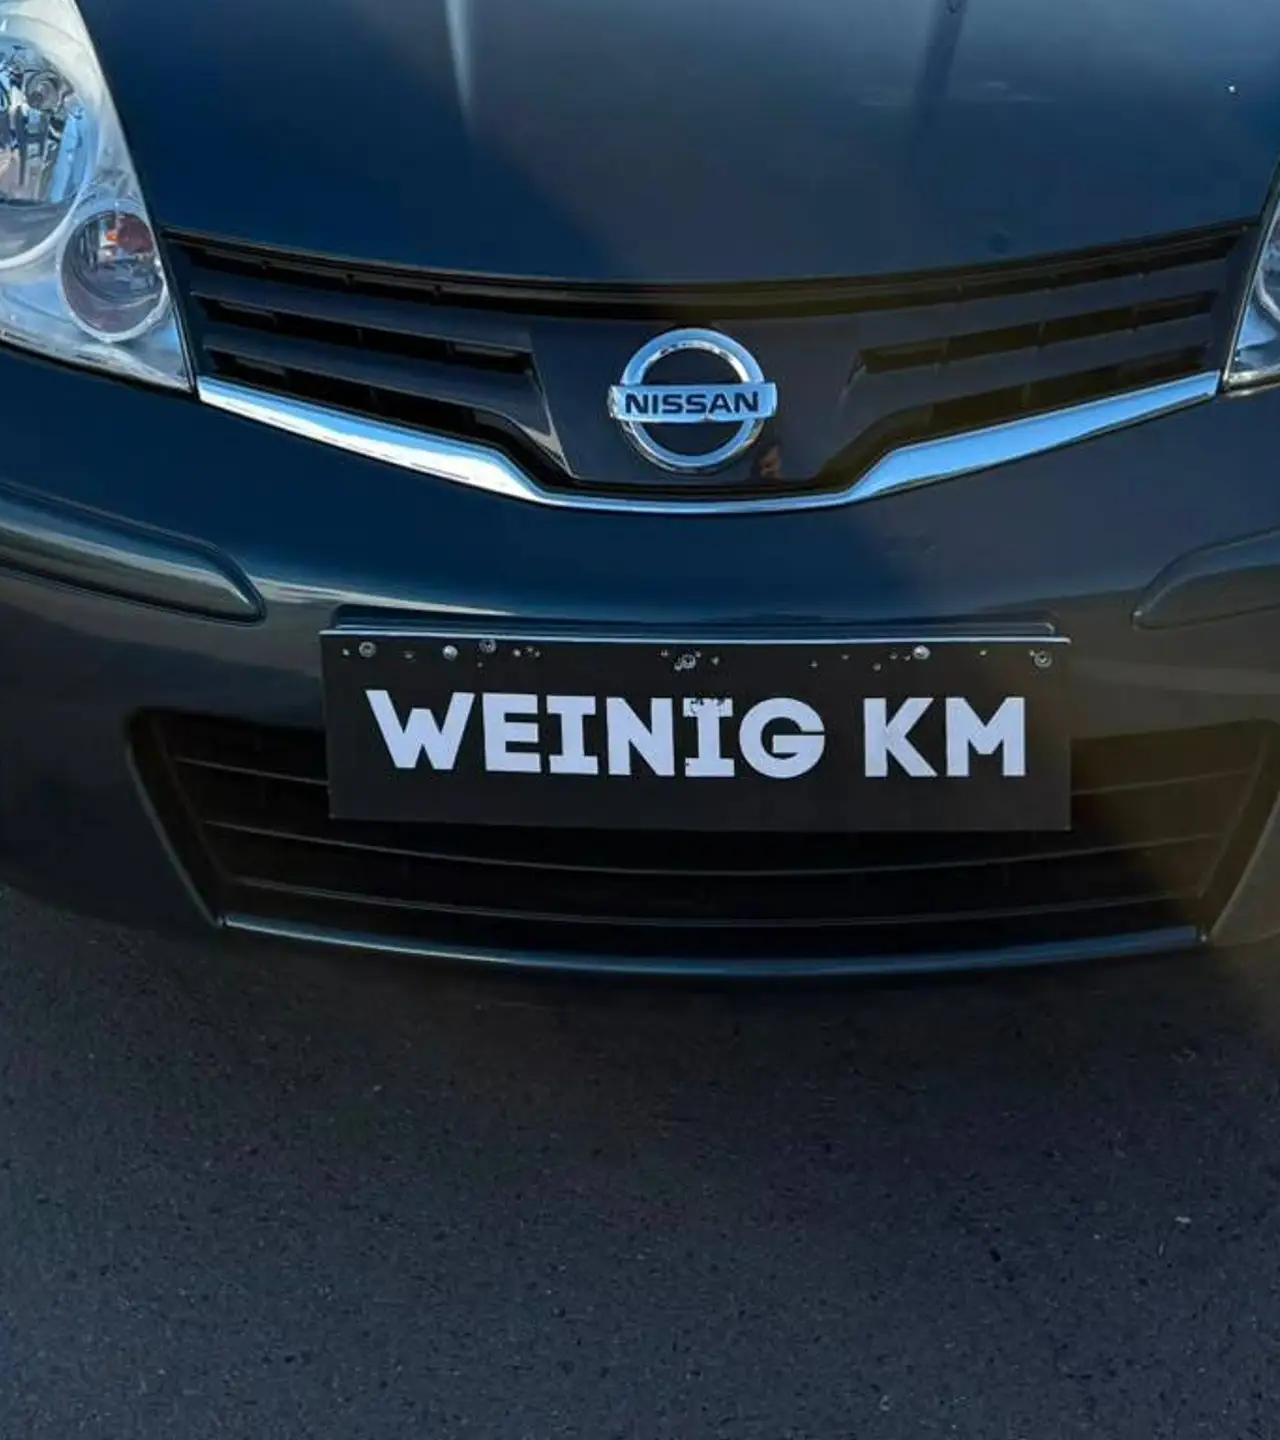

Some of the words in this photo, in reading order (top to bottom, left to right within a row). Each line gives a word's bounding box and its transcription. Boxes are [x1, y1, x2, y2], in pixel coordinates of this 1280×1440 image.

[625, 391, 759, 414] NISSAN
[365, 689, 825, 779] WEINIG
[863, 696, 1026, 778] KM
